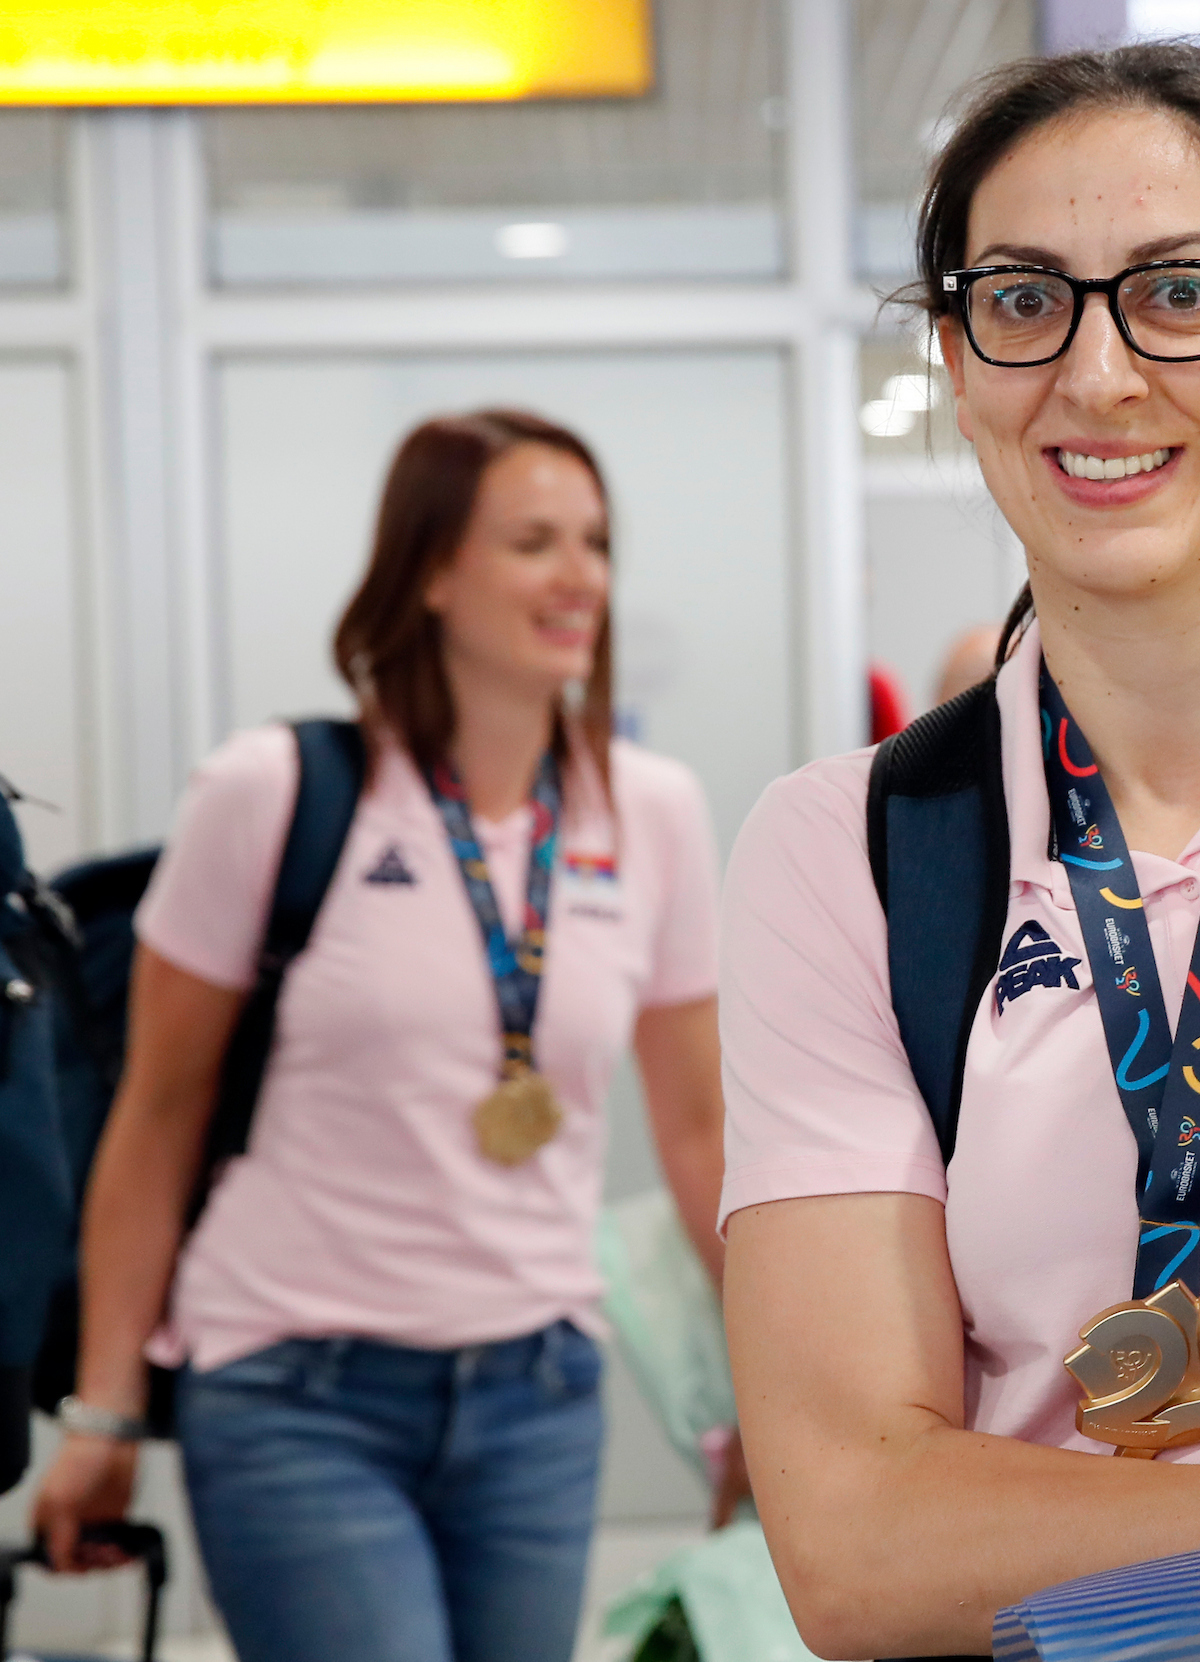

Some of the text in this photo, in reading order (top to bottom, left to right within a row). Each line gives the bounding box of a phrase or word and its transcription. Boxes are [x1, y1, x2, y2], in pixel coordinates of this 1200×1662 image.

[1105, 917, 1125, 966] EUROBASKET
[996, 955, 1082, 1017] PEAK
[1176, 1150, 1195, 1201] EUROBASKET
